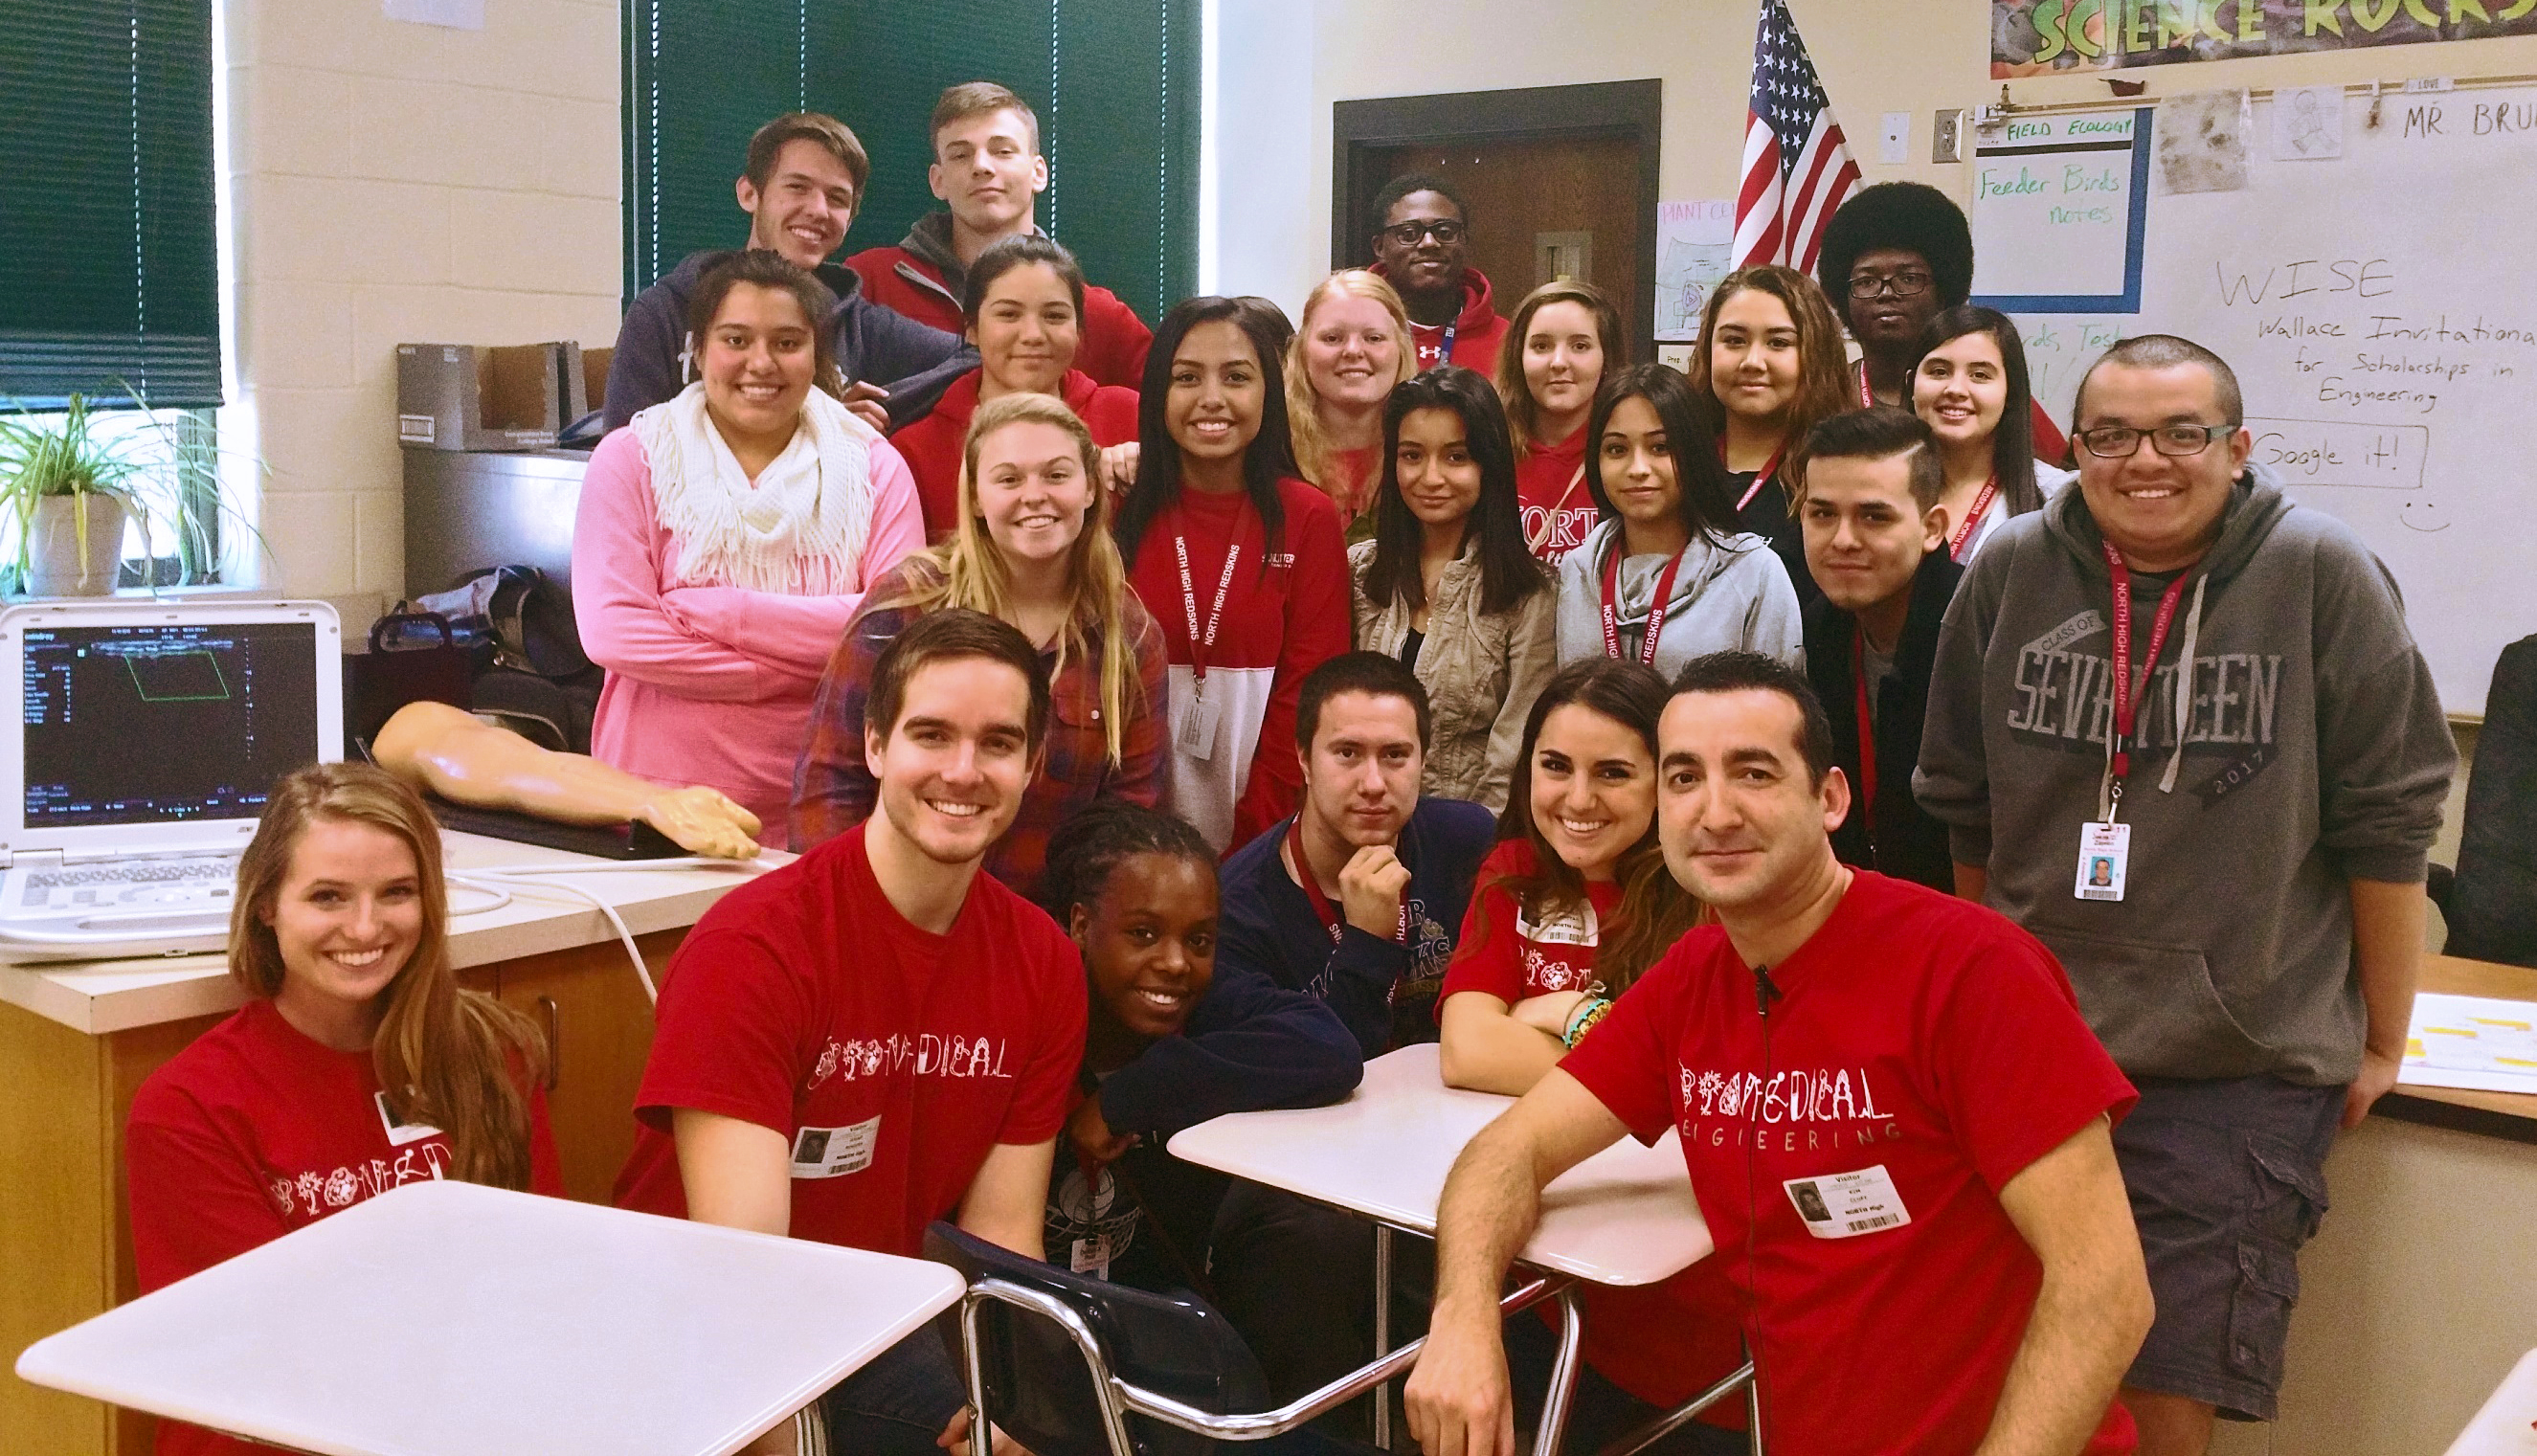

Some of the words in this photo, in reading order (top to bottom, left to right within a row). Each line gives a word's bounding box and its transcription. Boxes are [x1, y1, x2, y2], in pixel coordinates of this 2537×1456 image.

[2032, 0, 2267, 64] SCIENCE
[2008, 123, 2051, 141] FIELD
[2068, 119, 2132, 136] ECOLOGY
[2473, 101, 2537, 136] BRU
[1980, 166, 2051, 199] Feeder
[2064, 164, 2120, 194] Birds
[2216, 259, 2393, 306] WISE
[2258, 316, 2346, 339] Wallace
[2294, 346, 2324, 372] for
[2493, 364, 2514, 378] in
[2319, 376, 2437, 414] Engineering
[2251, 433, 2344, 475] Google
[1518, 505, 1599, 548] ORT
[1175, 536, 1187, 567] NORTH
[1180, 568, 1191, 592] HIGH
[1204, 613, 1221, 646] NORTH
[1213, 587, 1226, 613] HIGH
[1220, 544, 1240, 588] REDSKINS
[1183, 592, 1200, 641] REDSKINS
[2117, 582, 2126, 622] NORTH
[1604, 604, 1614, 637] NORTH
[1643, 609, 1663, 658] REDSKINS
[2042, 625, 2076, 651] CLASS
[2077, 616, 2095, 631] OF
[2117, 624, 2126, 653] HIGH
[2213, 750, 2263, 794] 2017
